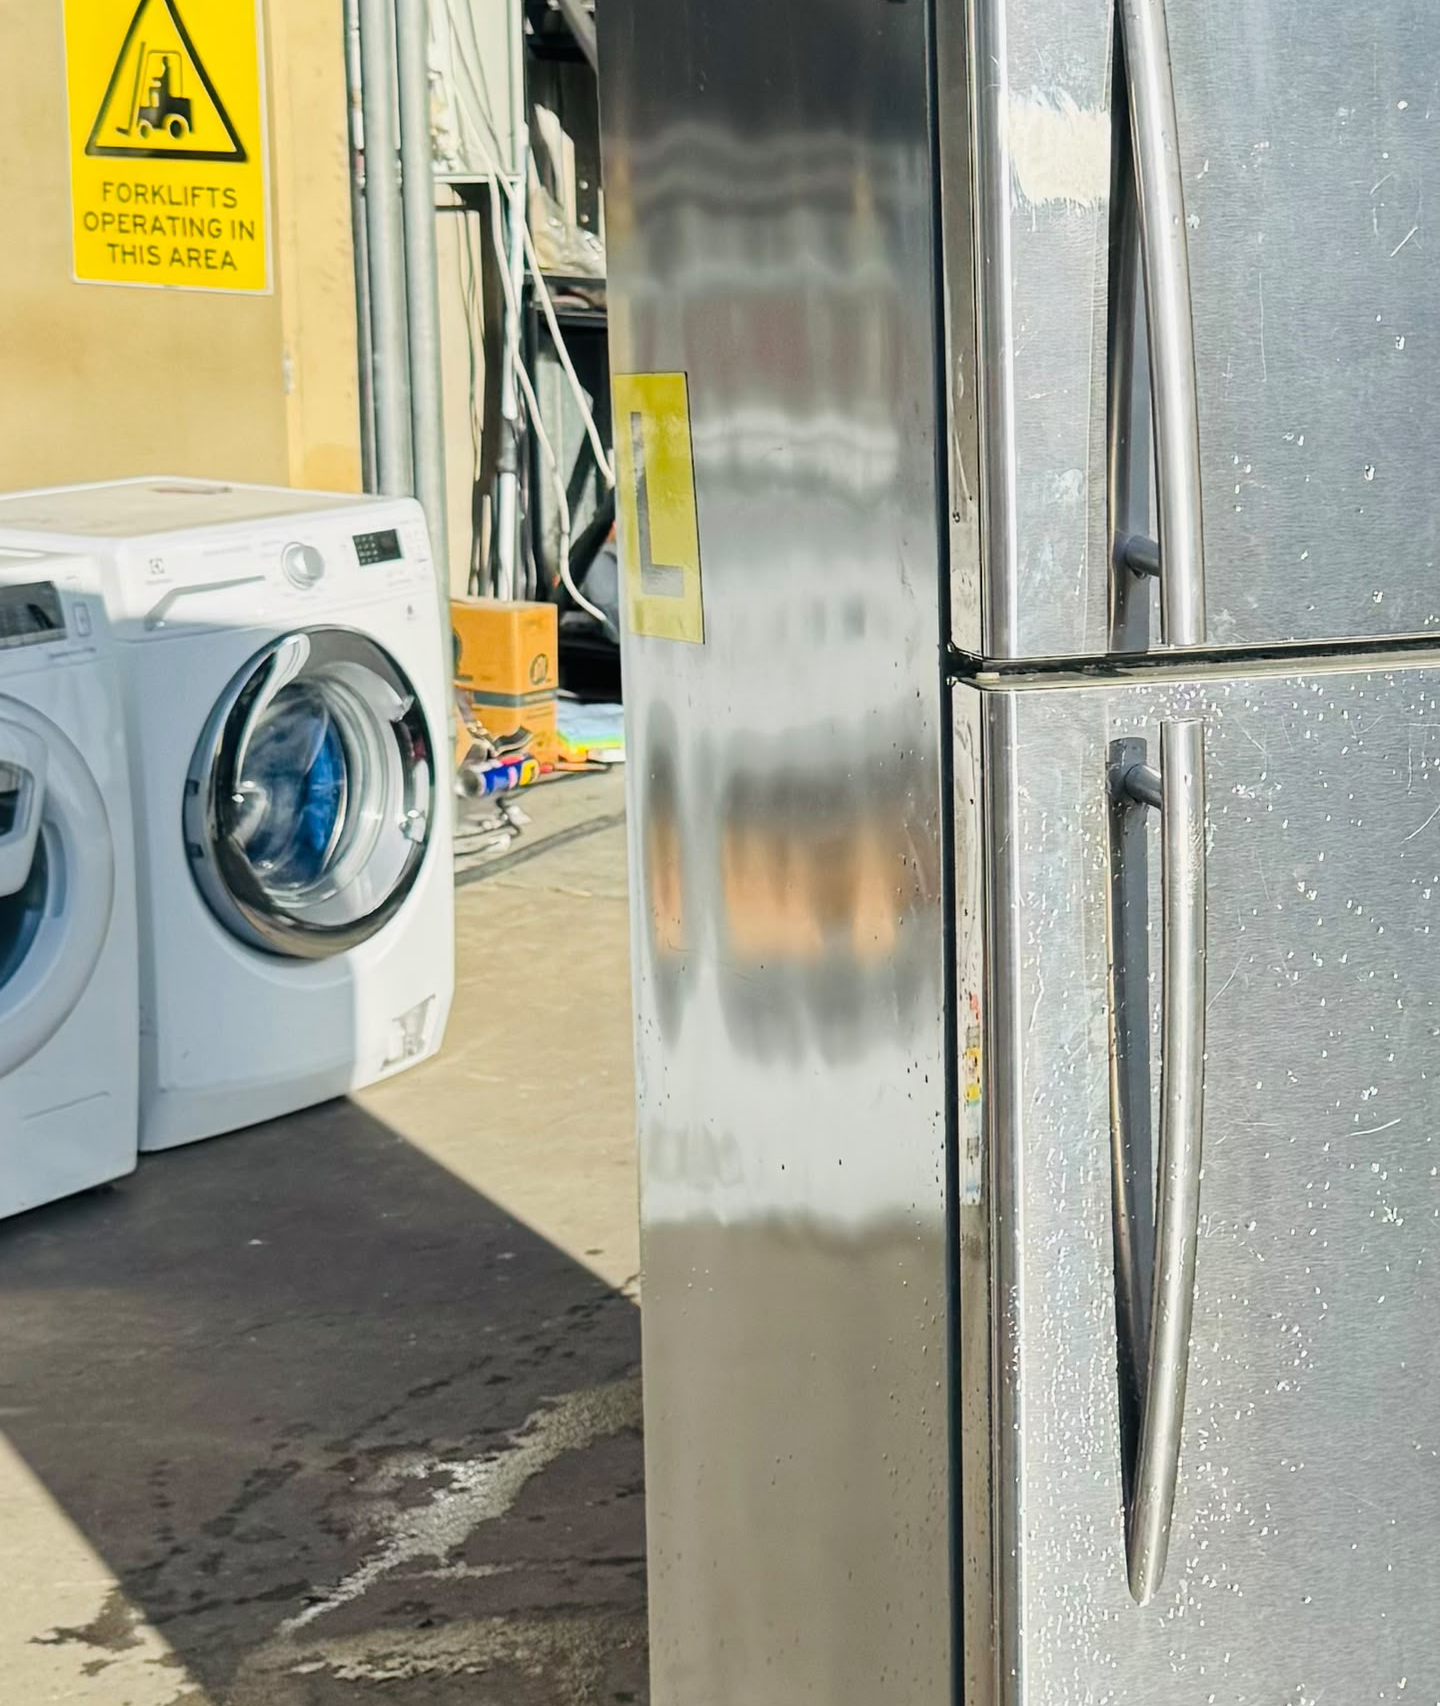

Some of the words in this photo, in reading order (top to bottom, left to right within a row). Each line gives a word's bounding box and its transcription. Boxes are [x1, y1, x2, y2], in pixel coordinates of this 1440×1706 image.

[102, 181, 238, 209] FORKLIFTS
[83, 211, 223, 239] OPERATING
[231, 219, 255, 241] IN
[106, 243, 161, 266] THIS
[169, 246, 238, 271] AREA
